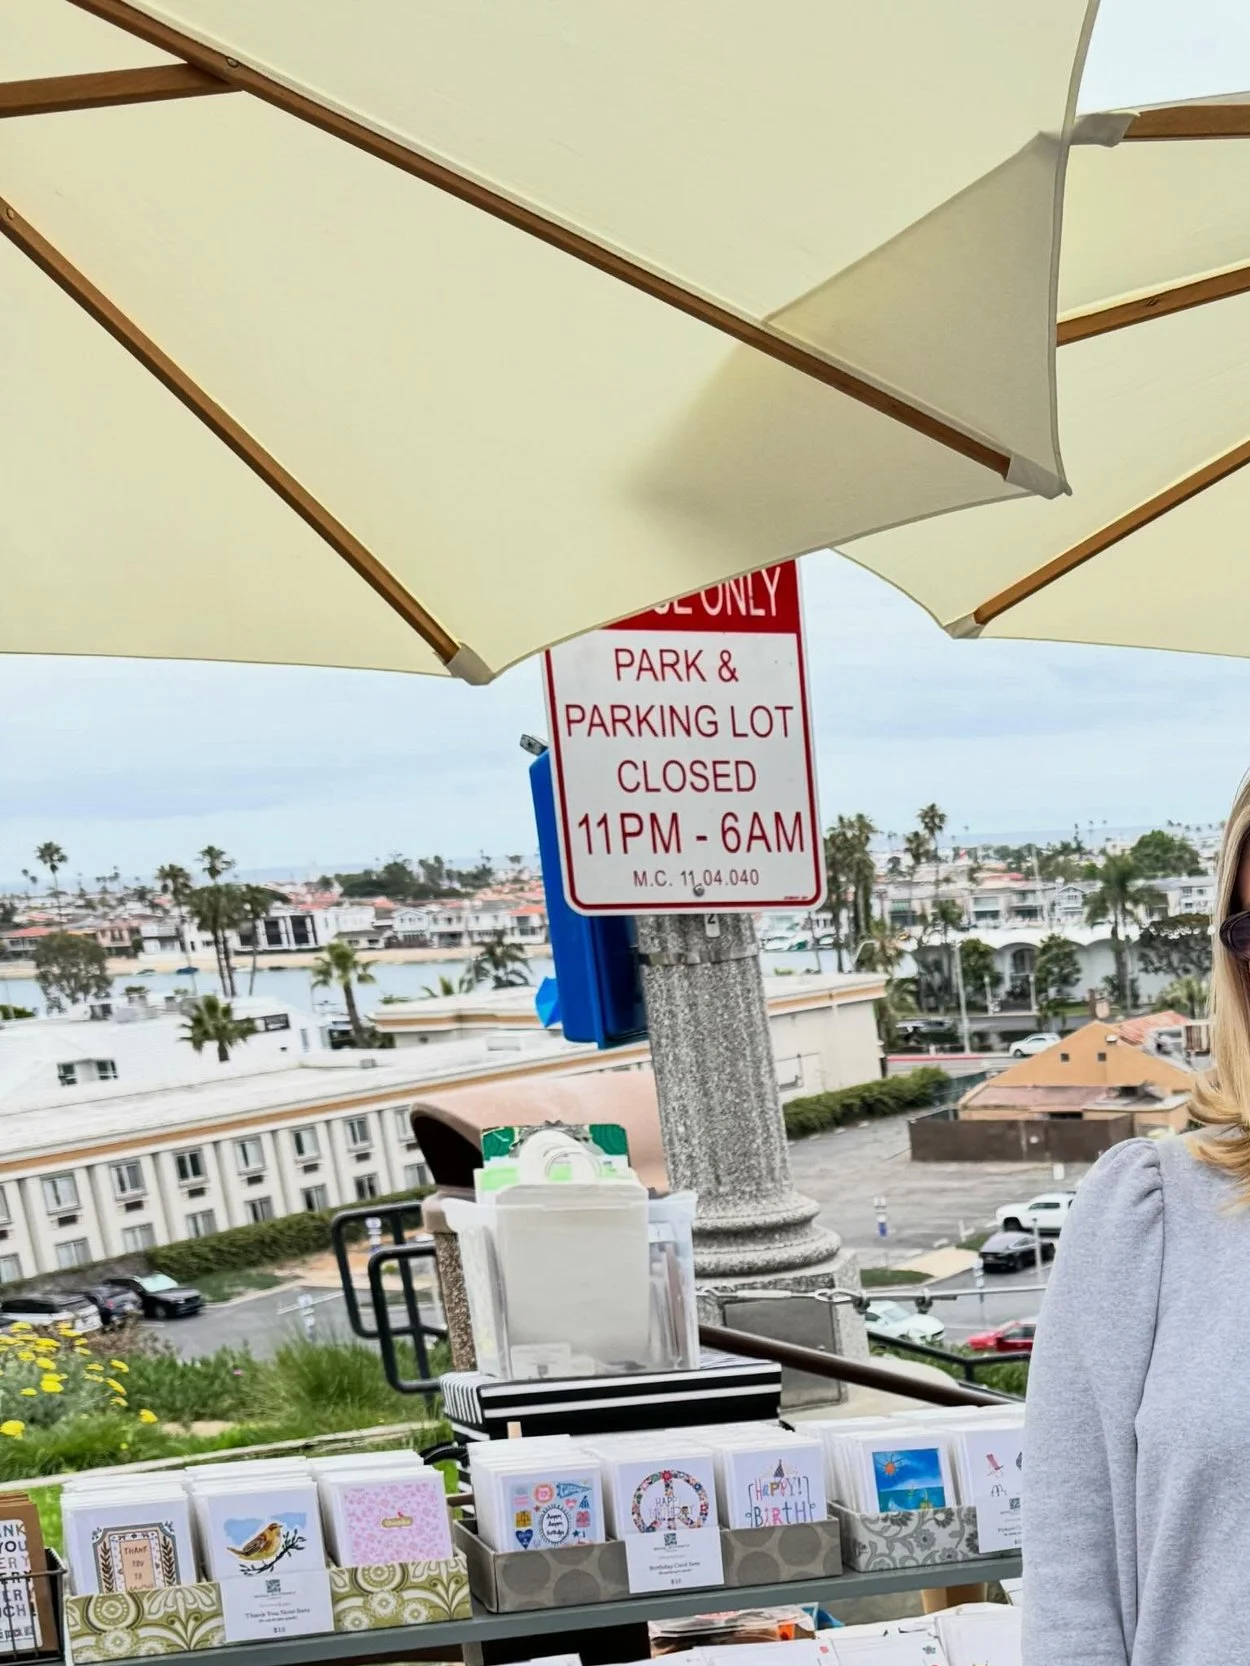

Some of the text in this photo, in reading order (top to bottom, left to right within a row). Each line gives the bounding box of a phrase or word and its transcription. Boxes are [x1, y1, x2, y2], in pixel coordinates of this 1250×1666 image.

[700, 567, 781, 616] ONLY
[614, 649, 739, 682] PARK &
[565, 705, 794, 738] PARKING LOT
[617, 760, 757, 793] CLOSED
[578, 812, 682, 855] 11PM
[720, 811, 805, 853] 6AM
[633, 869, 760, 888] M.C. 11.04.040
